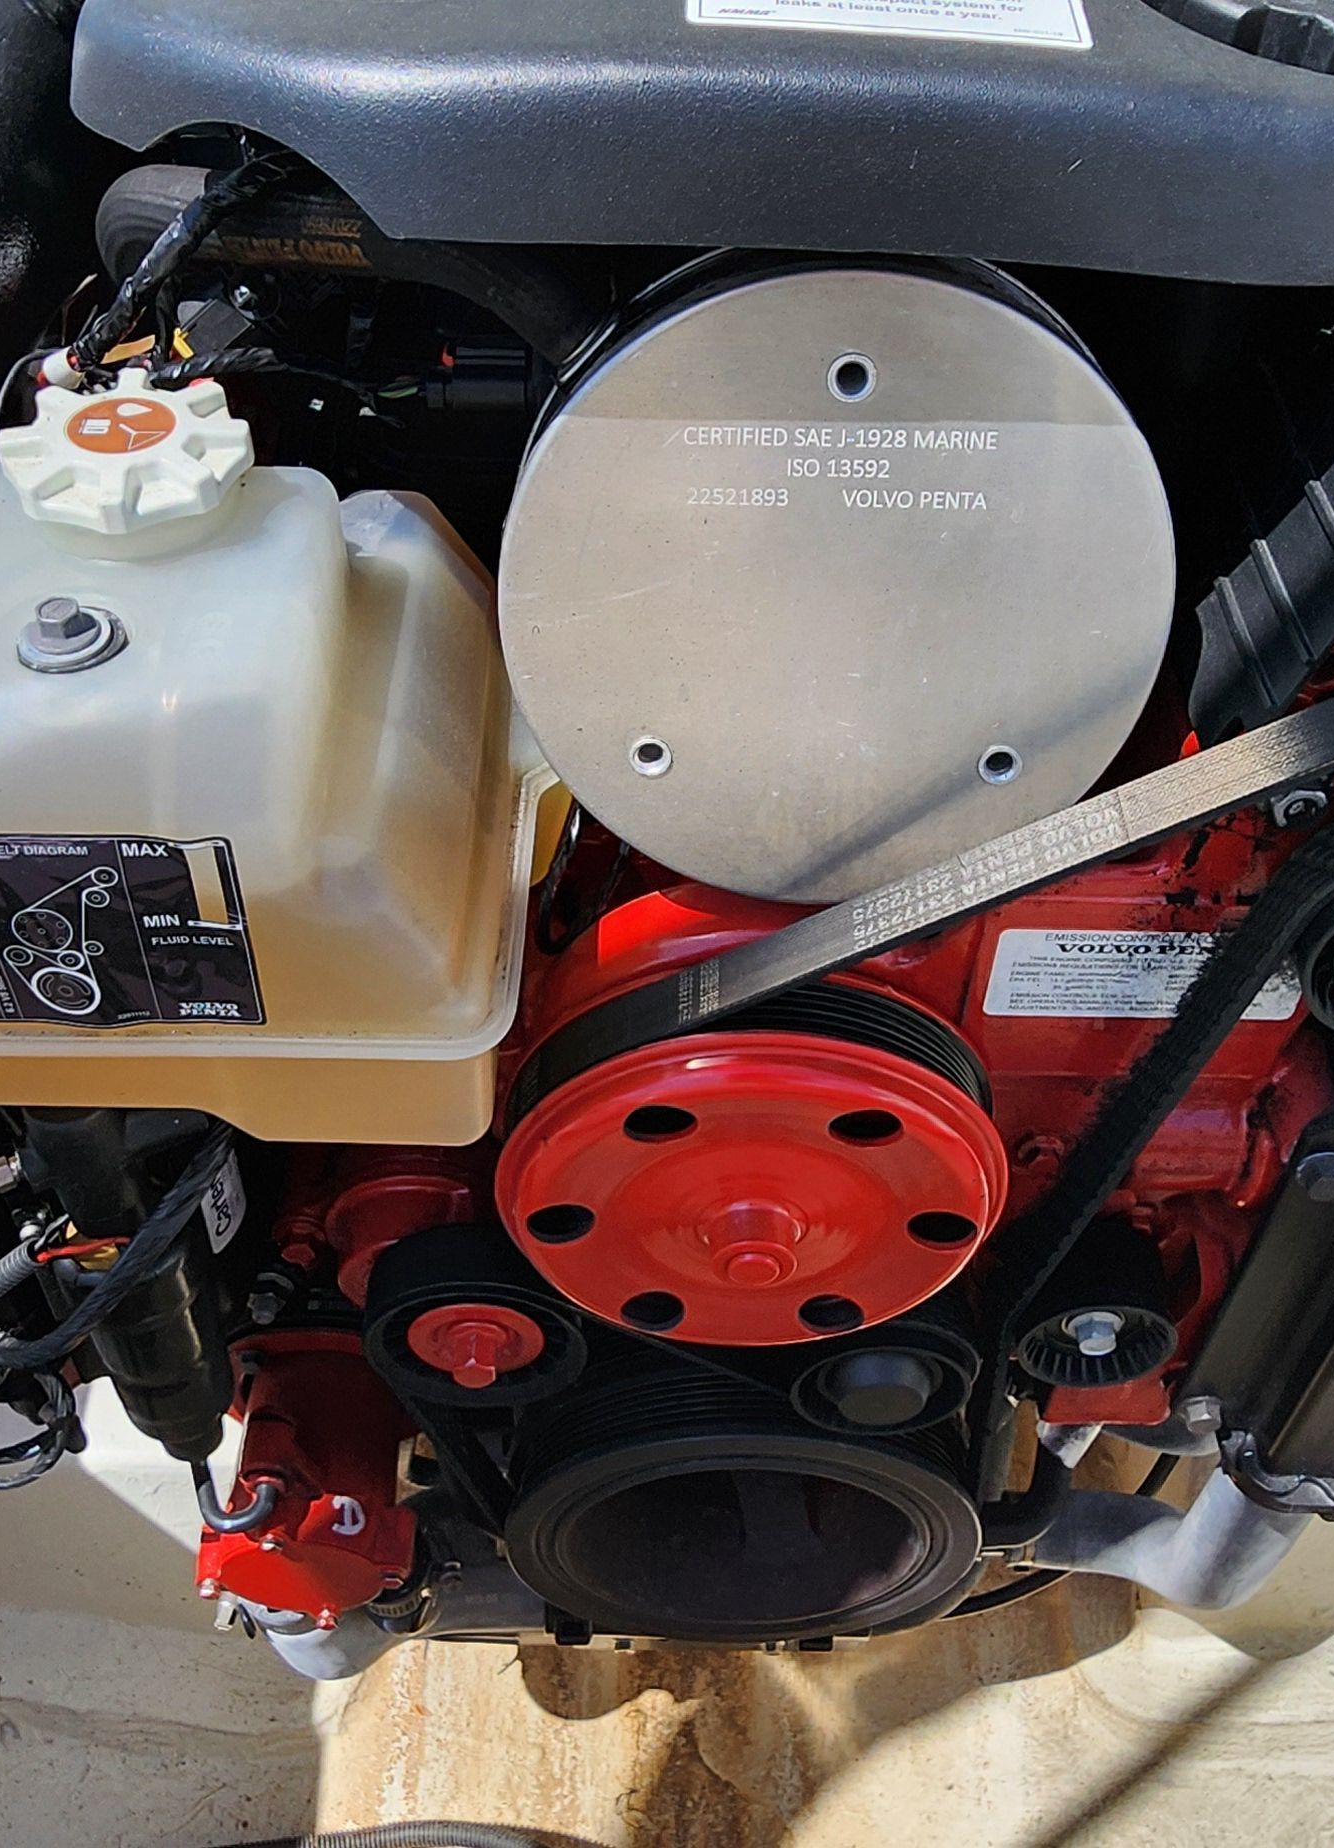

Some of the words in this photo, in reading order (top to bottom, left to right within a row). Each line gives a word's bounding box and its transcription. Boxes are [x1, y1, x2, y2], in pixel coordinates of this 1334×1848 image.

[849, 3, 891, 12] least
[896, 7, 939, 15] once
[683, 426, 788, 447] CERTIFIED
[793, 427, 833, 448] SAE
[837, 428, 908, 449] J-1928
[913, 430, 999, 450] MARINE
[787, 458, 821, 478] ISO
[827, 459, 891, 479] 13592
[686, 487, 790, 507] 22521893
[842, 489, 914, 509] VOLVO
[919, 490, 988, 511] PENTA
[23, 845, 89, 857] DIAGRAM
[121, 843, 169, 858] MAX
[143, 914, 181, 928] MIN
[151, 935, 190, 946] FLUID
[192, 935, 234, 947] LEVEL
[1045, 932, 1113, 942] EMISSION
[1057, 943, 1152, 954] VOLVO
[1155, 944, 1210, 956] PEN
[178, 1002, 238, 1010] VOLVO
[178, 1008, 242, 1017] PENTA
